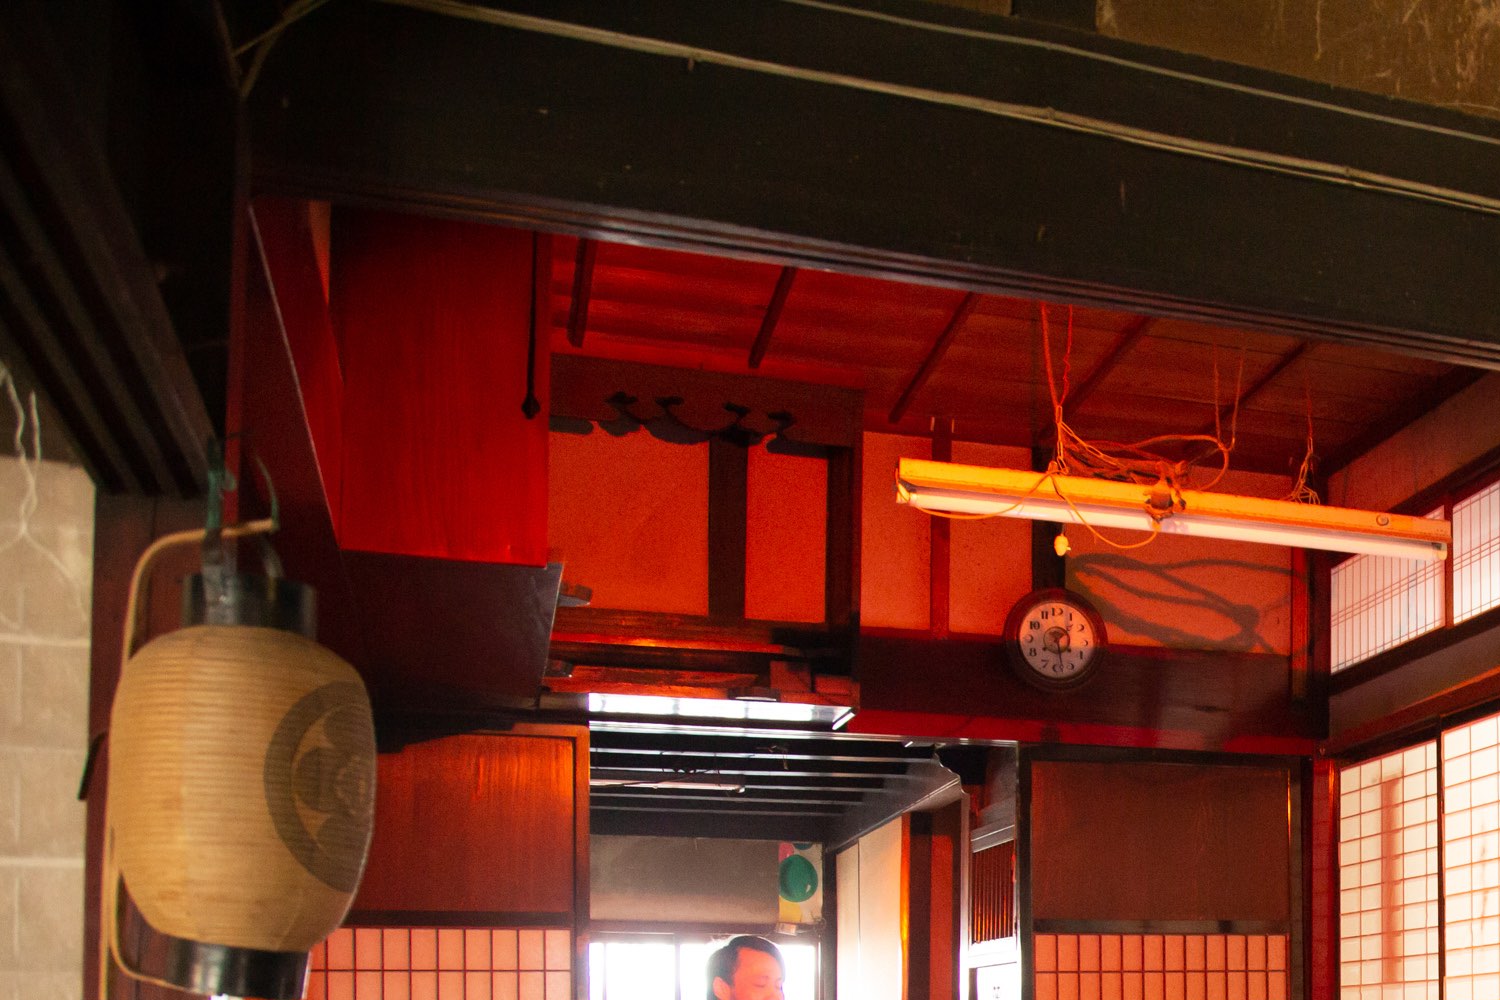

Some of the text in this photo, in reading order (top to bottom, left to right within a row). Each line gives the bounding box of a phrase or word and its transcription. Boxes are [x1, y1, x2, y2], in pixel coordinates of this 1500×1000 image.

[1041, 611, 1048, 619] 11
[1030, 621, 1040, 630] 10
[1029, 648, 1037, 657] 8
[1041, 659, 1049, 668] 7
